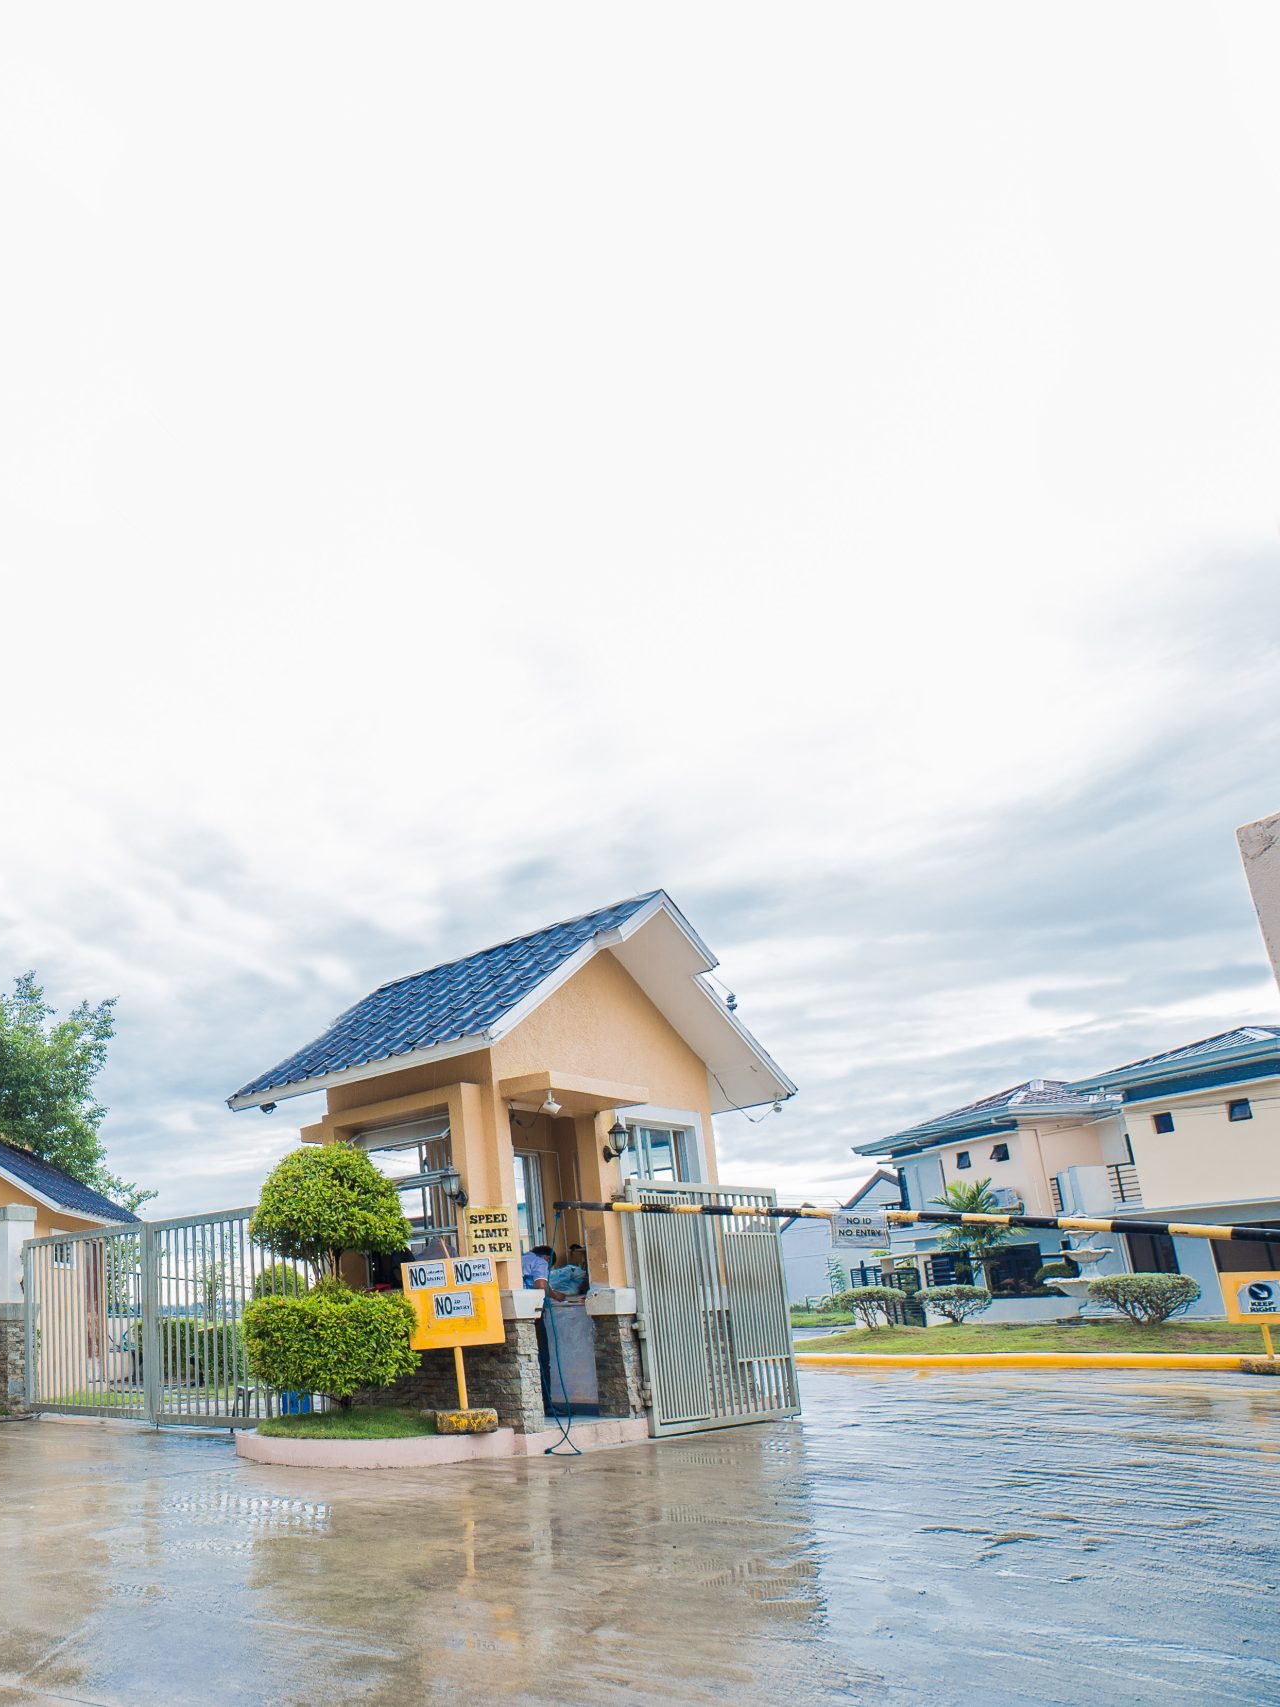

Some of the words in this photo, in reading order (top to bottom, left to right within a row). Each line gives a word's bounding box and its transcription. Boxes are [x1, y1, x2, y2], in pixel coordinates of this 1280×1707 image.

[470, 1214, 507, 1224] SPEED
[846, 1217, 860, 1225] NO
[863, 1217, 872, 1225] ID
[473, 1228, 509, 1239] LIMIT
[838, 1229, 853, 1237] NO
[856, 1229, 881, 1237] ENTRY
[472, 1244, 486, 1253] 10
[488, 1243, 512, 1252] KPH
[410, 1267, 426, 1287] NO
[455, 1263, 472, 1282] NO
[435, 1296, 452, 1316] NO
